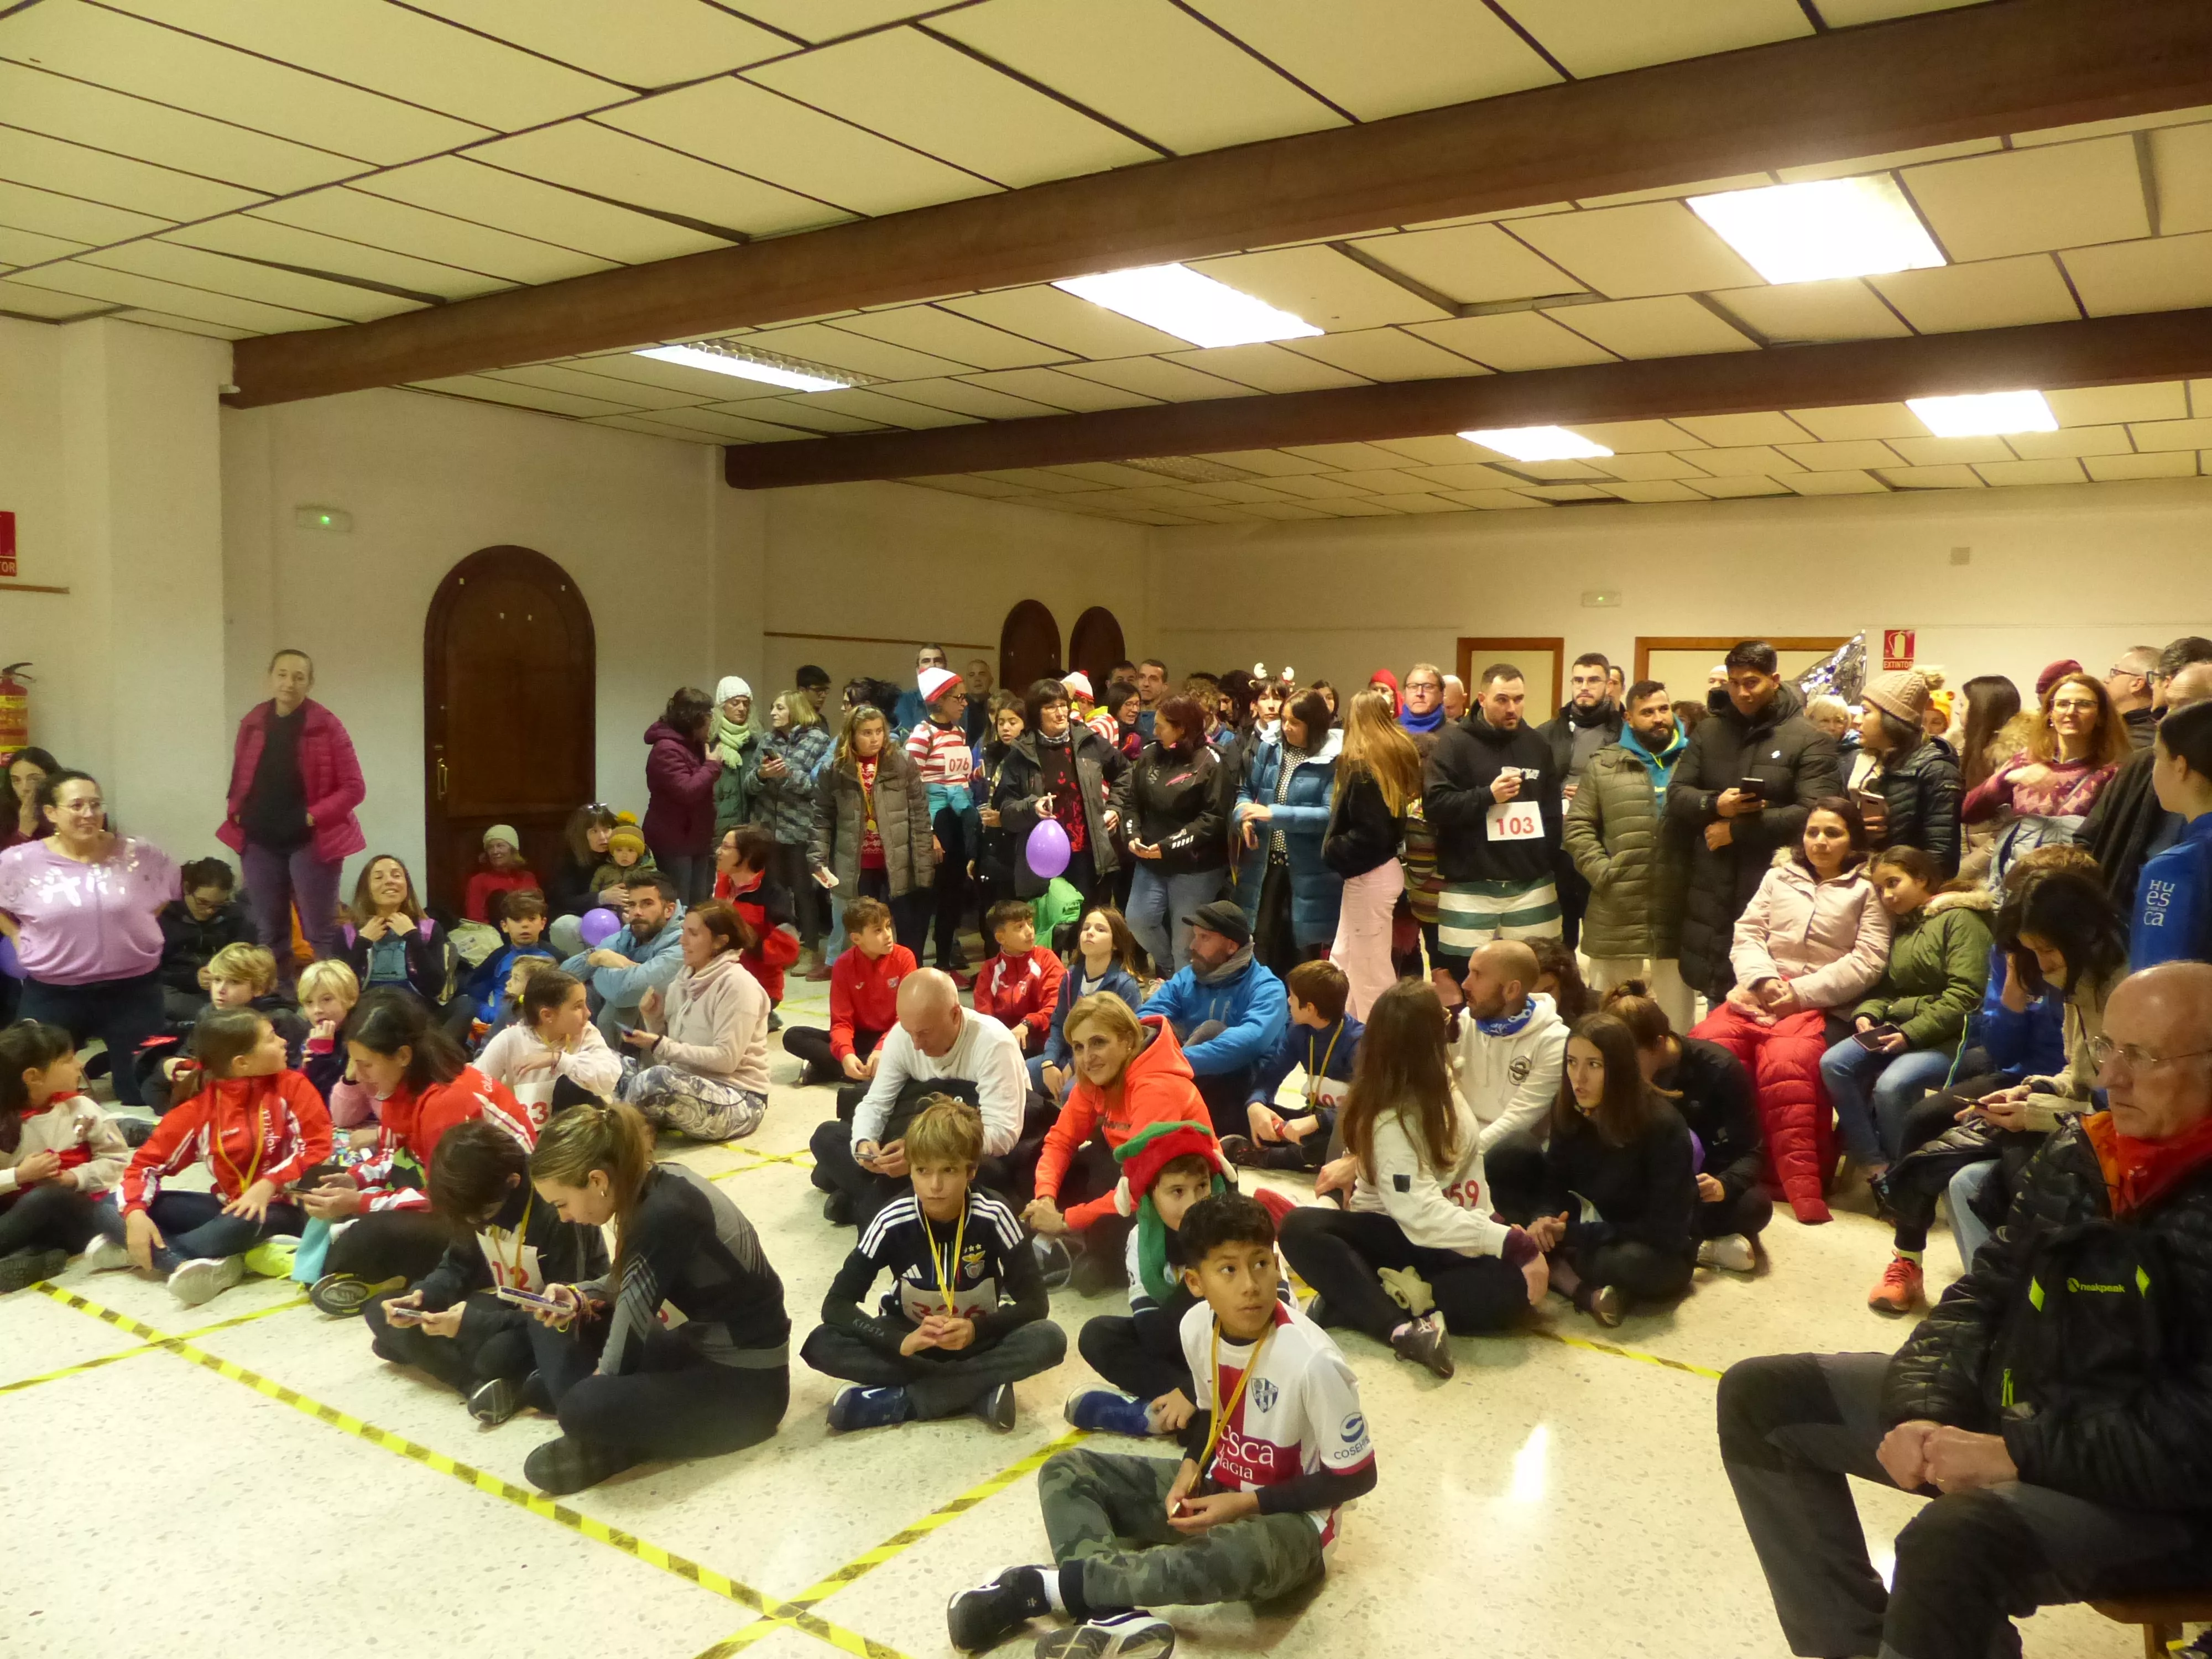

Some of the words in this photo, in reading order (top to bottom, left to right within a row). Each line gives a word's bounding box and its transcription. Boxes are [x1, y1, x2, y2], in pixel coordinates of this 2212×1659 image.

[0, 561, 15, 573] OR
[949, 758, 969, 772] 076
[1496, 817, 1534, 835] 103
[523, 1102, 549, 1124] 3
[1442, 1180, 1479, 1207] 59
[492, 1261, 533, 1292] 12
